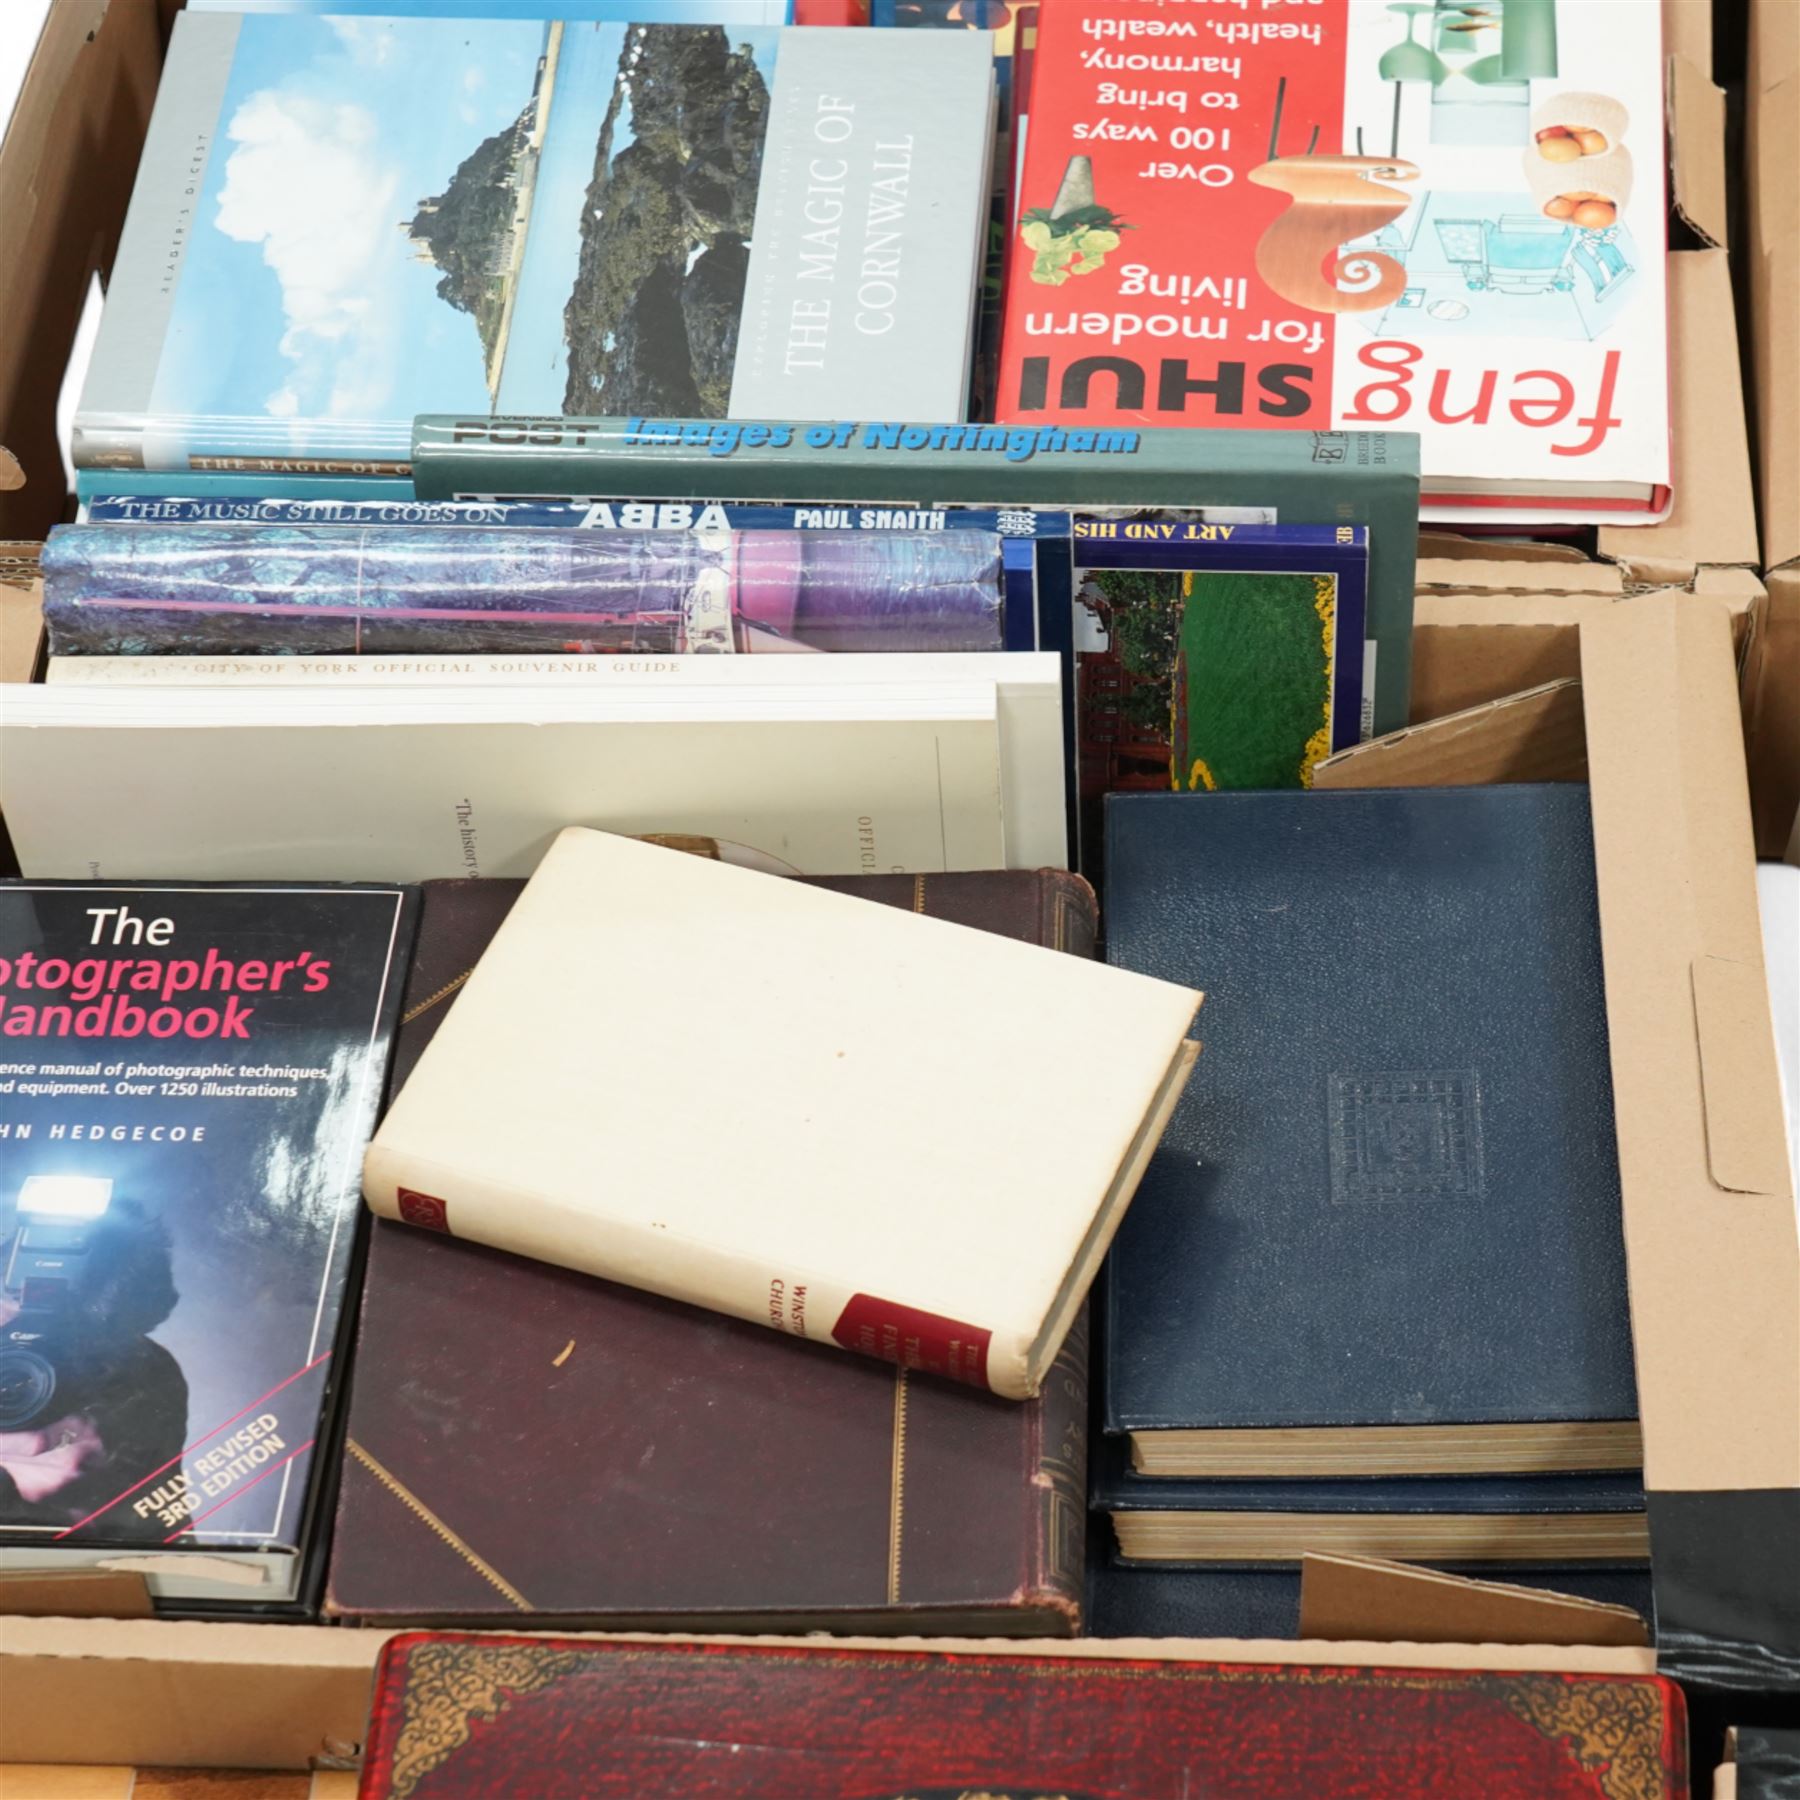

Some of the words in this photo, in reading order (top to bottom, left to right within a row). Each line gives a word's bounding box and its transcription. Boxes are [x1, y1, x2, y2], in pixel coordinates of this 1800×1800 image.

[1082, 19, 1197, 41] wealth
[1206, 20, 1321, 45] health,
[1080, 47, 1240, 79] harmony,
[1097, 82, 1187, 113] bring
[1200, 92, 1240, 110] to
[814, 94, 855, 143] OF
[1072, 118, 1158, 142] ways
[1170, 127, 1230, 151] 100
[185, 133, 208, 195] DIGEST
[1138, 162, 1233, 187] Over
[796, 159, 848, 282] MAGIC
[855, 134, 914, 335] CORNWALL
[1118, 264, 1247, 309] living
[783, 299, 831, 375] THE
[1025, 313, 1227, 345] modern
[1246, 320, 1324, 353] for
[1018, 355, 1313, 417] SHUI
[1341, 340, 1622, 457] feng
[452, 422, 599, 445] POST
[623, 417, 796, 458] Images
[803, 422, 857, 449] of
[862, 422, 1142, 462] Nottingham
[199, 458, 245, 470] THE
[259, 460, 337, 473] MAGIC
[351, 462, 382, 474] OF
[119, 503, 180, 518] THE
[187, 503, 281, 519] MUSIC
[287, 503, 371, 521] STILL
[379, 505, 457, 522] GOES
[464, 505, 509, 522] ON
[578, 504, 731, 529] ABBA
[794, 510, 852, 528] PAUL
[860, 511, 945, 529] SNAITH
[1074, 522, 1117, 538] HIS
[1124, 524, 1176, 539] AND
[1183, 524, 1234, 541] ART
[194, 663, 244, 674] CITY
[260, 663, 287, 674] OF
[301, 663, 359, 673] YORK
[373, 663, 476, 673] OFFICIAL
[489, 662, 598, 673] SOUVENIR
[613, 662, 681, 673] GUIDE
[460, 828, 479, 868] history
[86, 906, 174, 946] The
[0, 995, 254, 1038] andbook
[40, 1062, 101, 1076] manual
[104, 1062, 125, 1077] of
[125, 1062, 235, 1080] photographic
[239, 1064, 329, 1081] techniques,
[18, 1081, 110, 1097] equipment.
[114, 1082, 156, 1095] Over
[160, 1082, 198, 1096] 1250
[201, 1082, 298, 1097] illustrations
[50, 1124, 205, 1141] HEDGECOE
[132, 1469, 194, 1519] FULLY
[193, 1413, 279, 1476] REVISED
[157, 1492, 202, 1528] 3RD
[201, 1433, 285, 1497] EDITION
